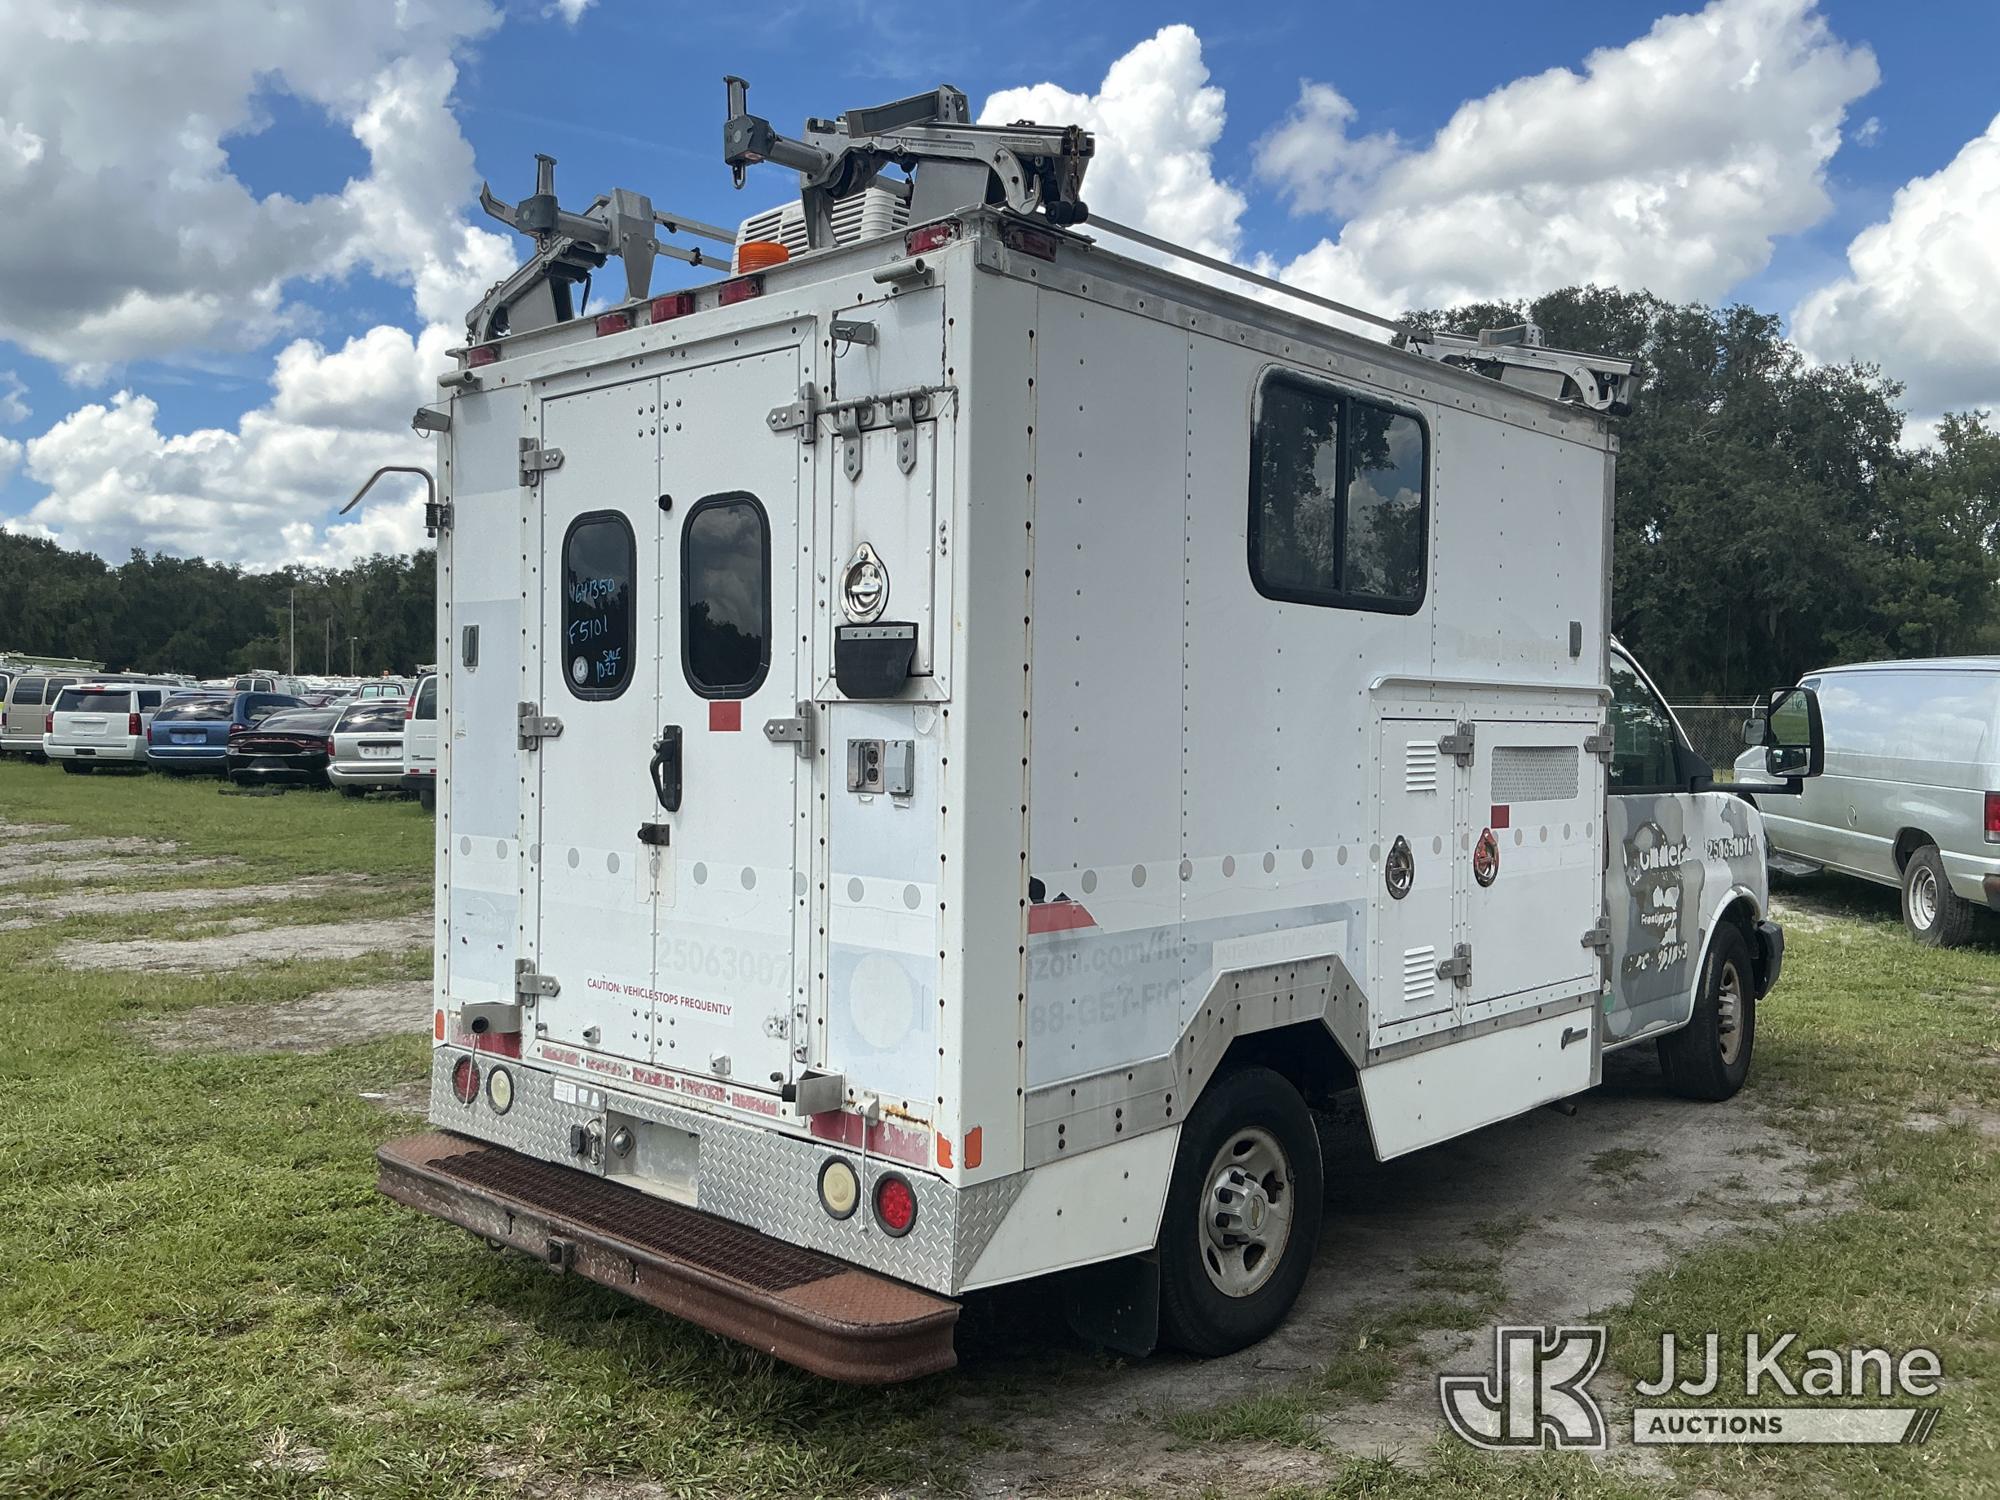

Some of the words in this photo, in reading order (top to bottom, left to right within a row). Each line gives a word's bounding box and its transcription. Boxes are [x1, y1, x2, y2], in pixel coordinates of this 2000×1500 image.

[587, 978, 622, 993] CAUTION:
[623, 984, 653, 1000] VEHICLE
[654, 991, 679, 1006] STOPS
[680, 996, 733, 1016] FREQUENTLY
